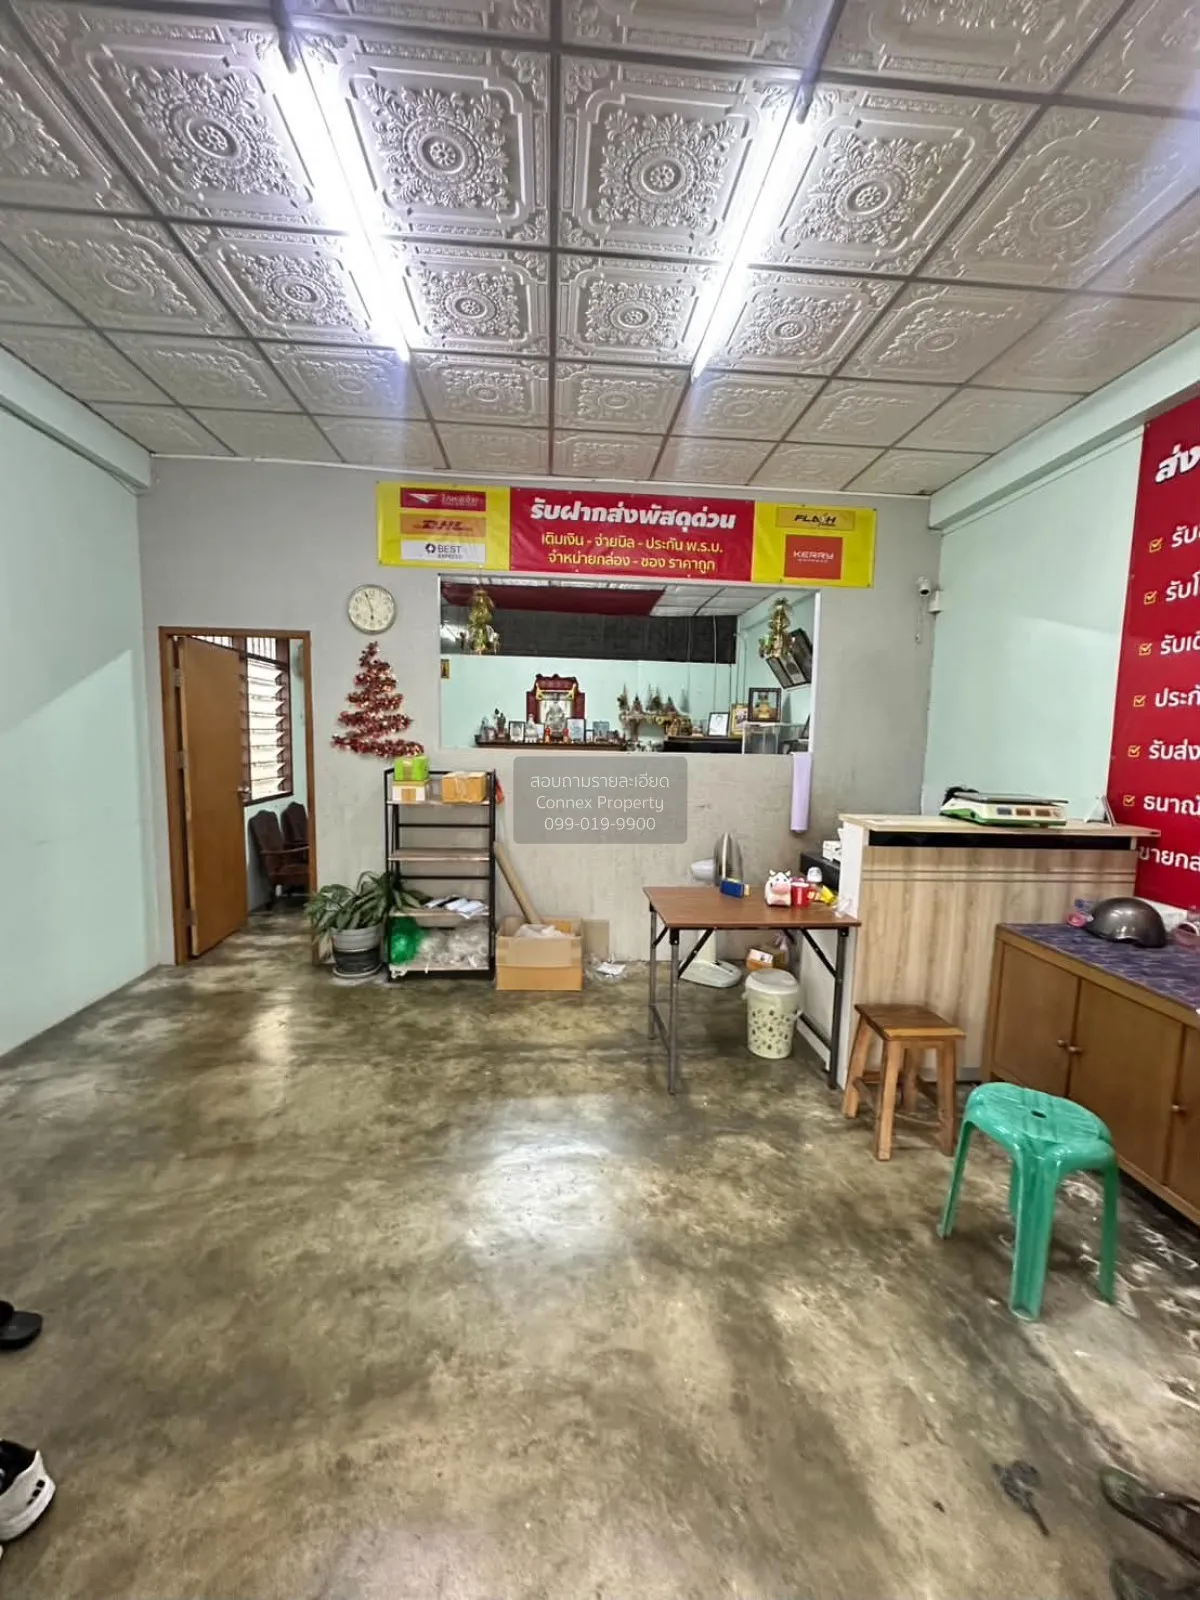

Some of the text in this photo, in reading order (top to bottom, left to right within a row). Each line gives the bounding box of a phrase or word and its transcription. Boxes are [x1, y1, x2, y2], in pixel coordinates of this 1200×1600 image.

[422, 519, 464, 531] DHL
[531, 497, 737, 533] รับฝากส่งพัสดุด่วน
[542, 531, 584, 547] เติมเงิน
[595, 533, 635, 549] จ่ายบิล
[646, 537, 683, 551] ประกัน
[686, 541, 724, 553] พ.ร.บ.
[1171, 524, 1200, 548] รับ
[438, 545, 463, 554] BEST
[793, 550, 835, 560] KERRY
[548, 549, 630, 566] จำหน่ายกล่อง
[669, 559, 716, 574] ราคาถูก
